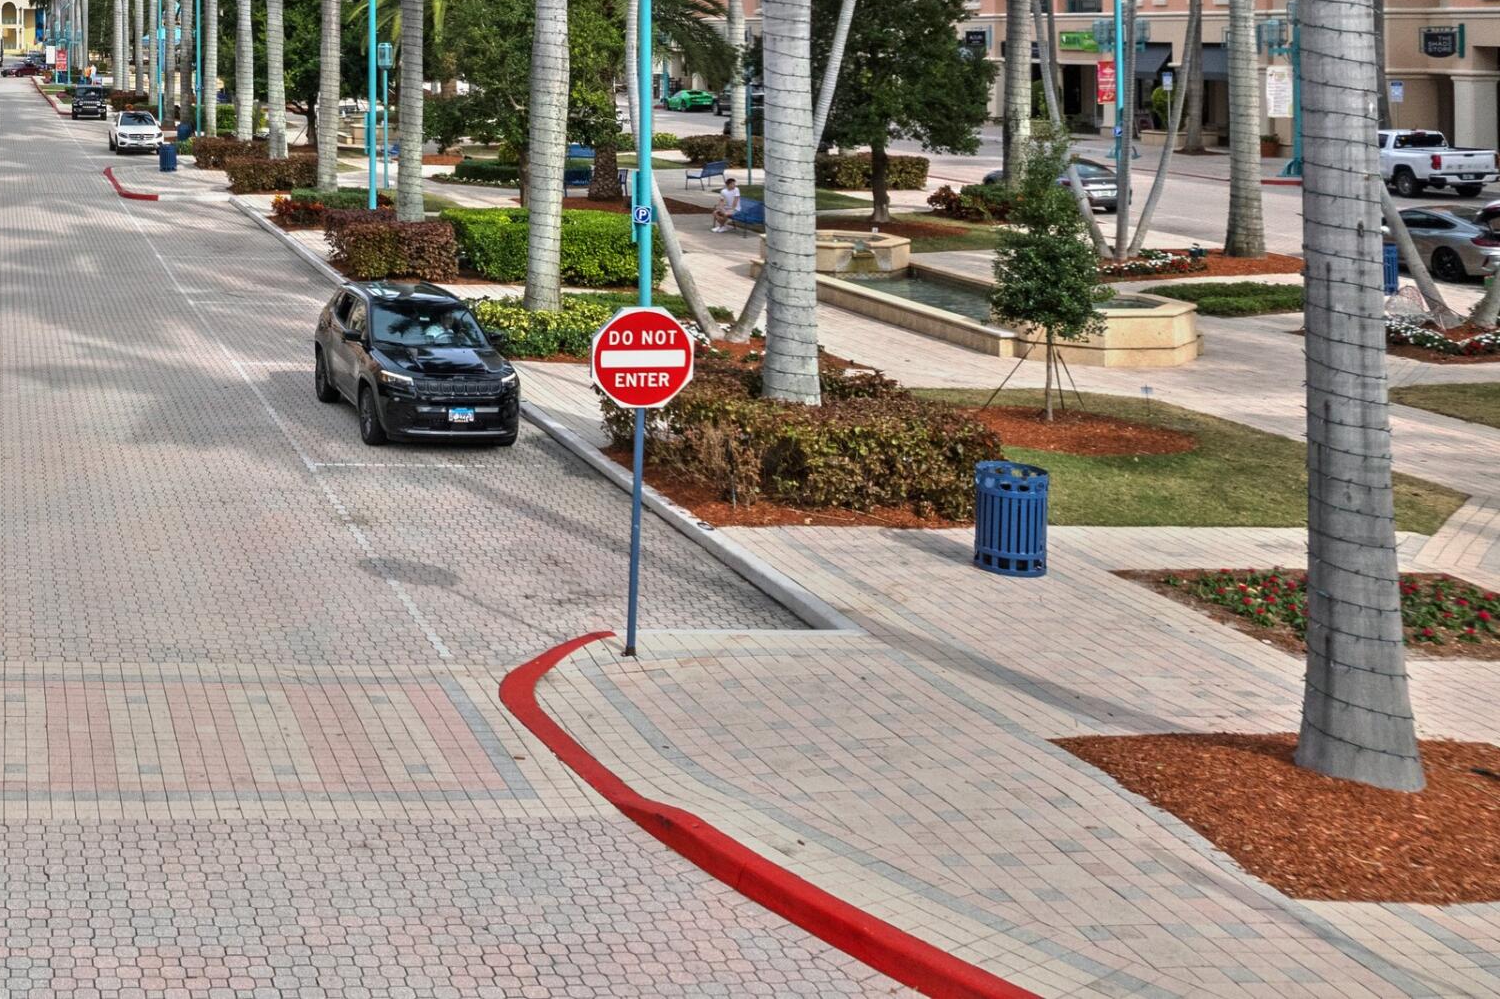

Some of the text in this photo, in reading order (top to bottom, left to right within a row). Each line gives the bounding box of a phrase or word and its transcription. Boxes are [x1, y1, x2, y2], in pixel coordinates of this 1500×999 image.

[638, 209, 647, 220] P
[609, 330, 678, 346] DO NOT
[614, 372, 670, 388] ENTER
